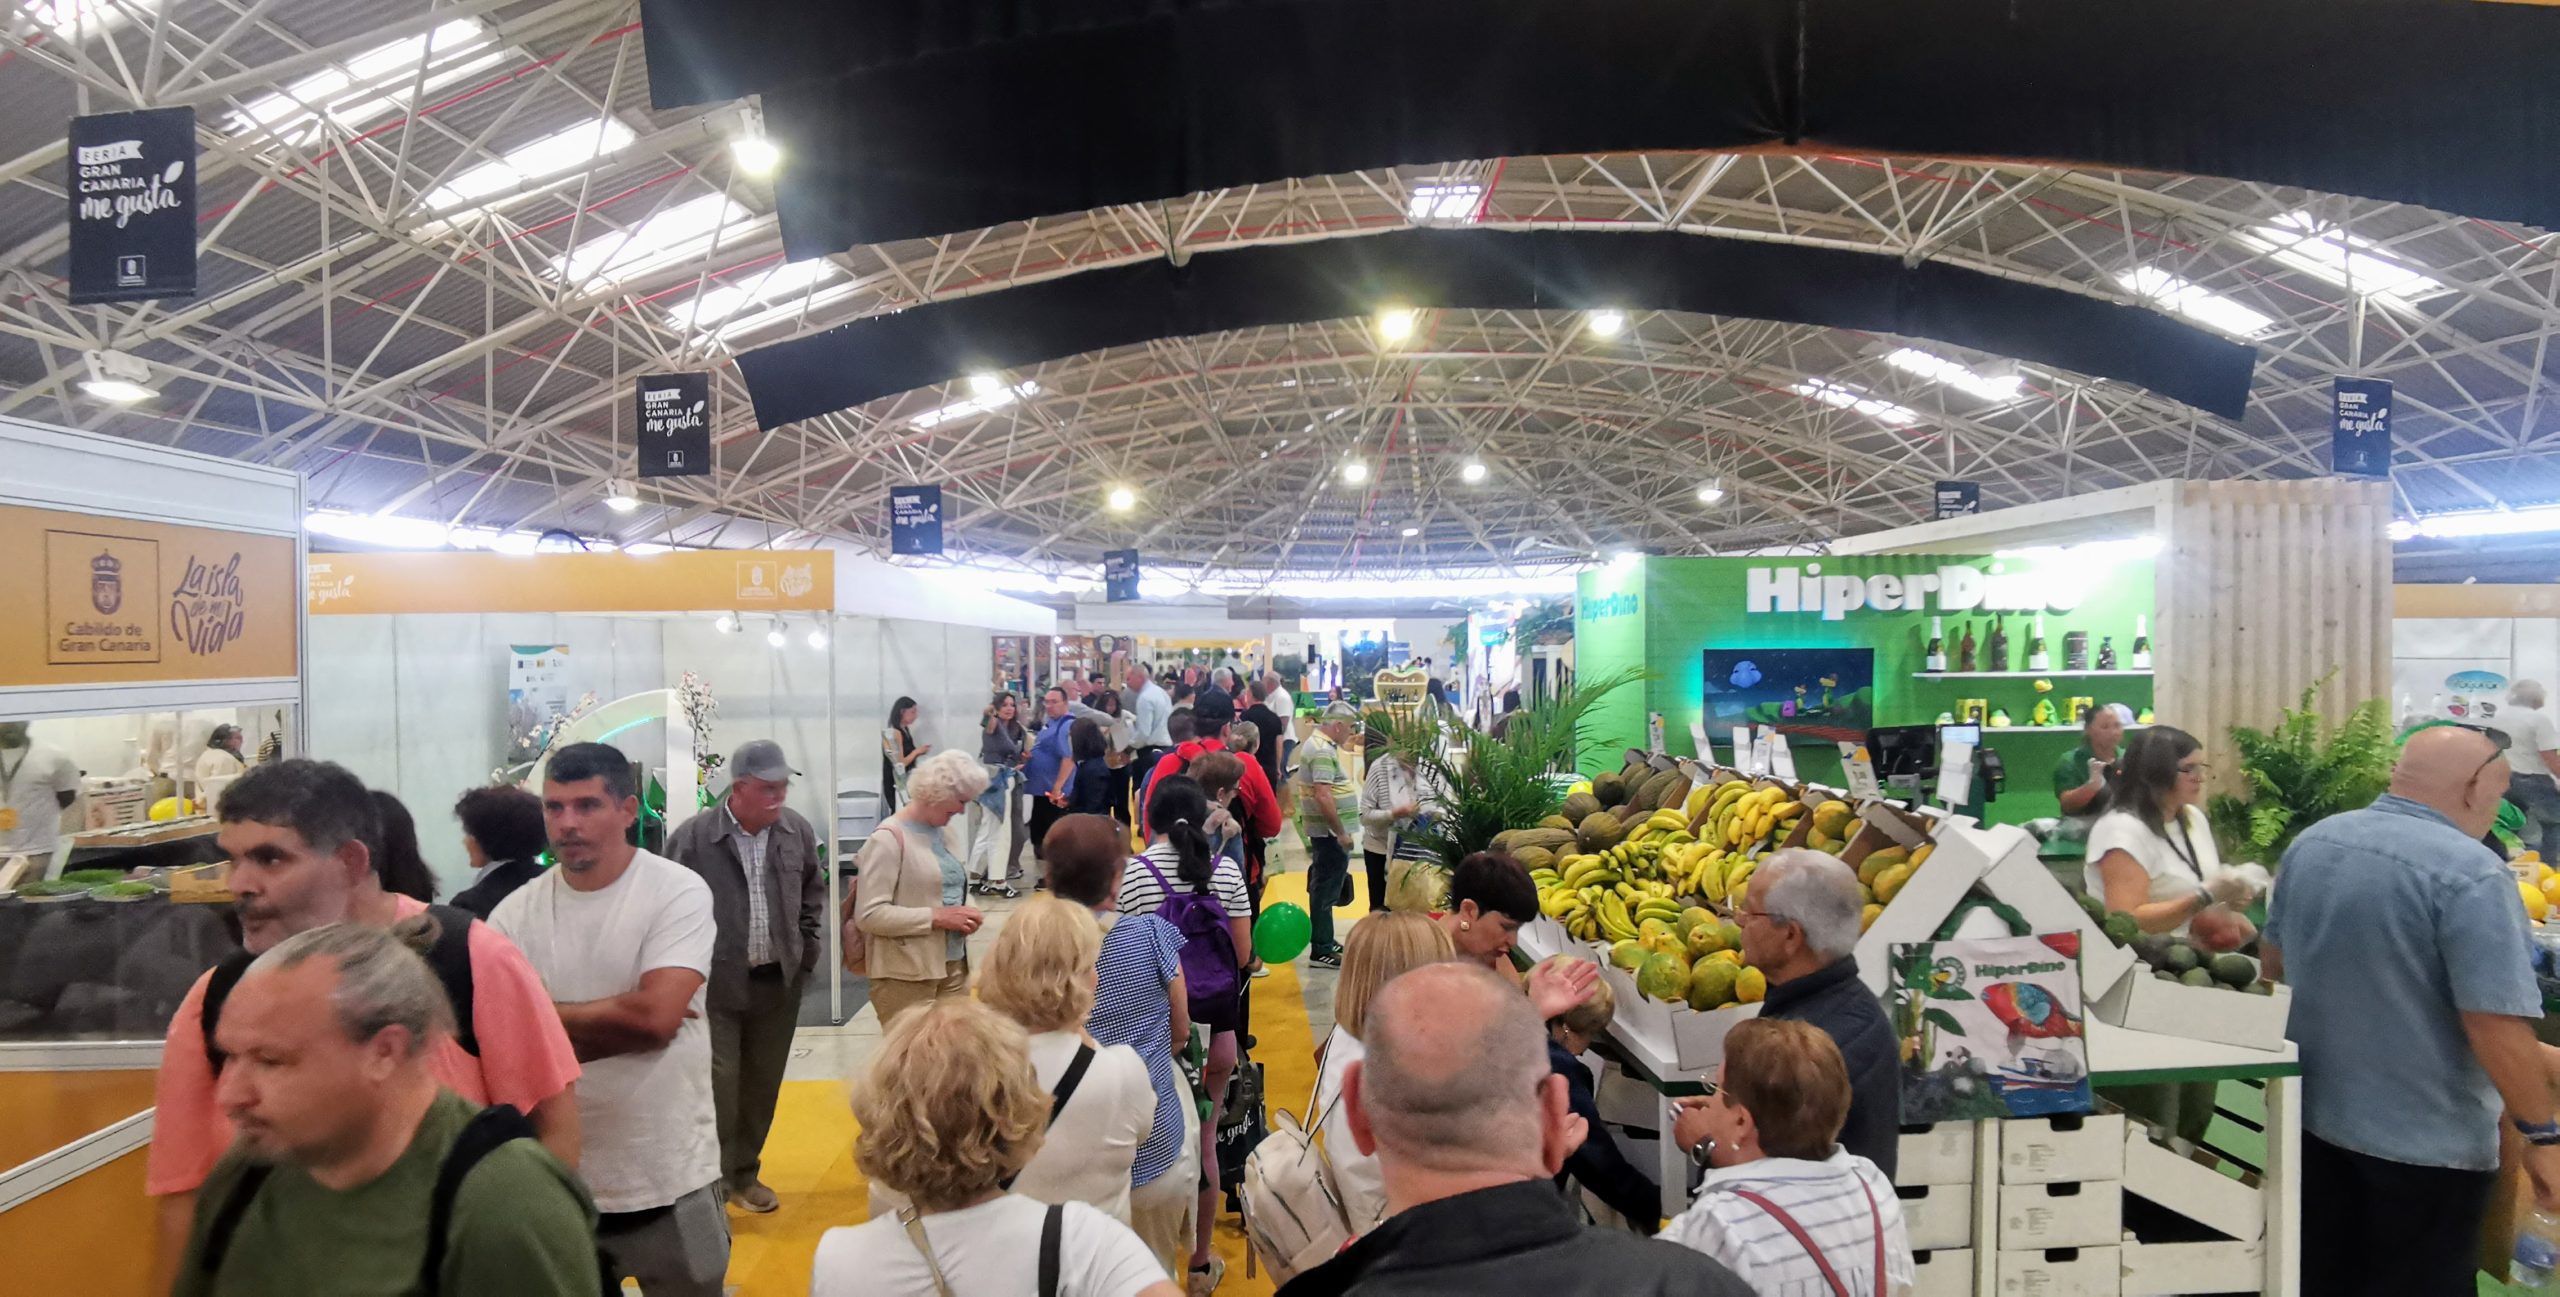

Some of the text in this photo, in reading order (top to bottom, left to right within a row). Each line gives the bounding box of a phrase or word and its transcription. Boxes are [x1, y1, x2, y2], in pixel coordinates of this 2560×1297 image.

[83, 145, 127, 161] FERIA
[79, 163, 122, 178] GRAN
[79, 176, 147, 193] CANARIA
[79, 173, 181, 229] me gusta
[645, 401, 669, 410] GRAN
[645, 408, 683, 418] CANARIA
[646, 406, 703, 437] me gusta
[2355, 412, 2386, 437] gusta
[172, 551, 244, 607] La isla
[66, 621, 143, 637] Cabildo de
[171, 599, 244, 656] Vida
[59, 637, 151, 652] Gran Canaria
[1974, 961, 2066, 979] HiperDino
